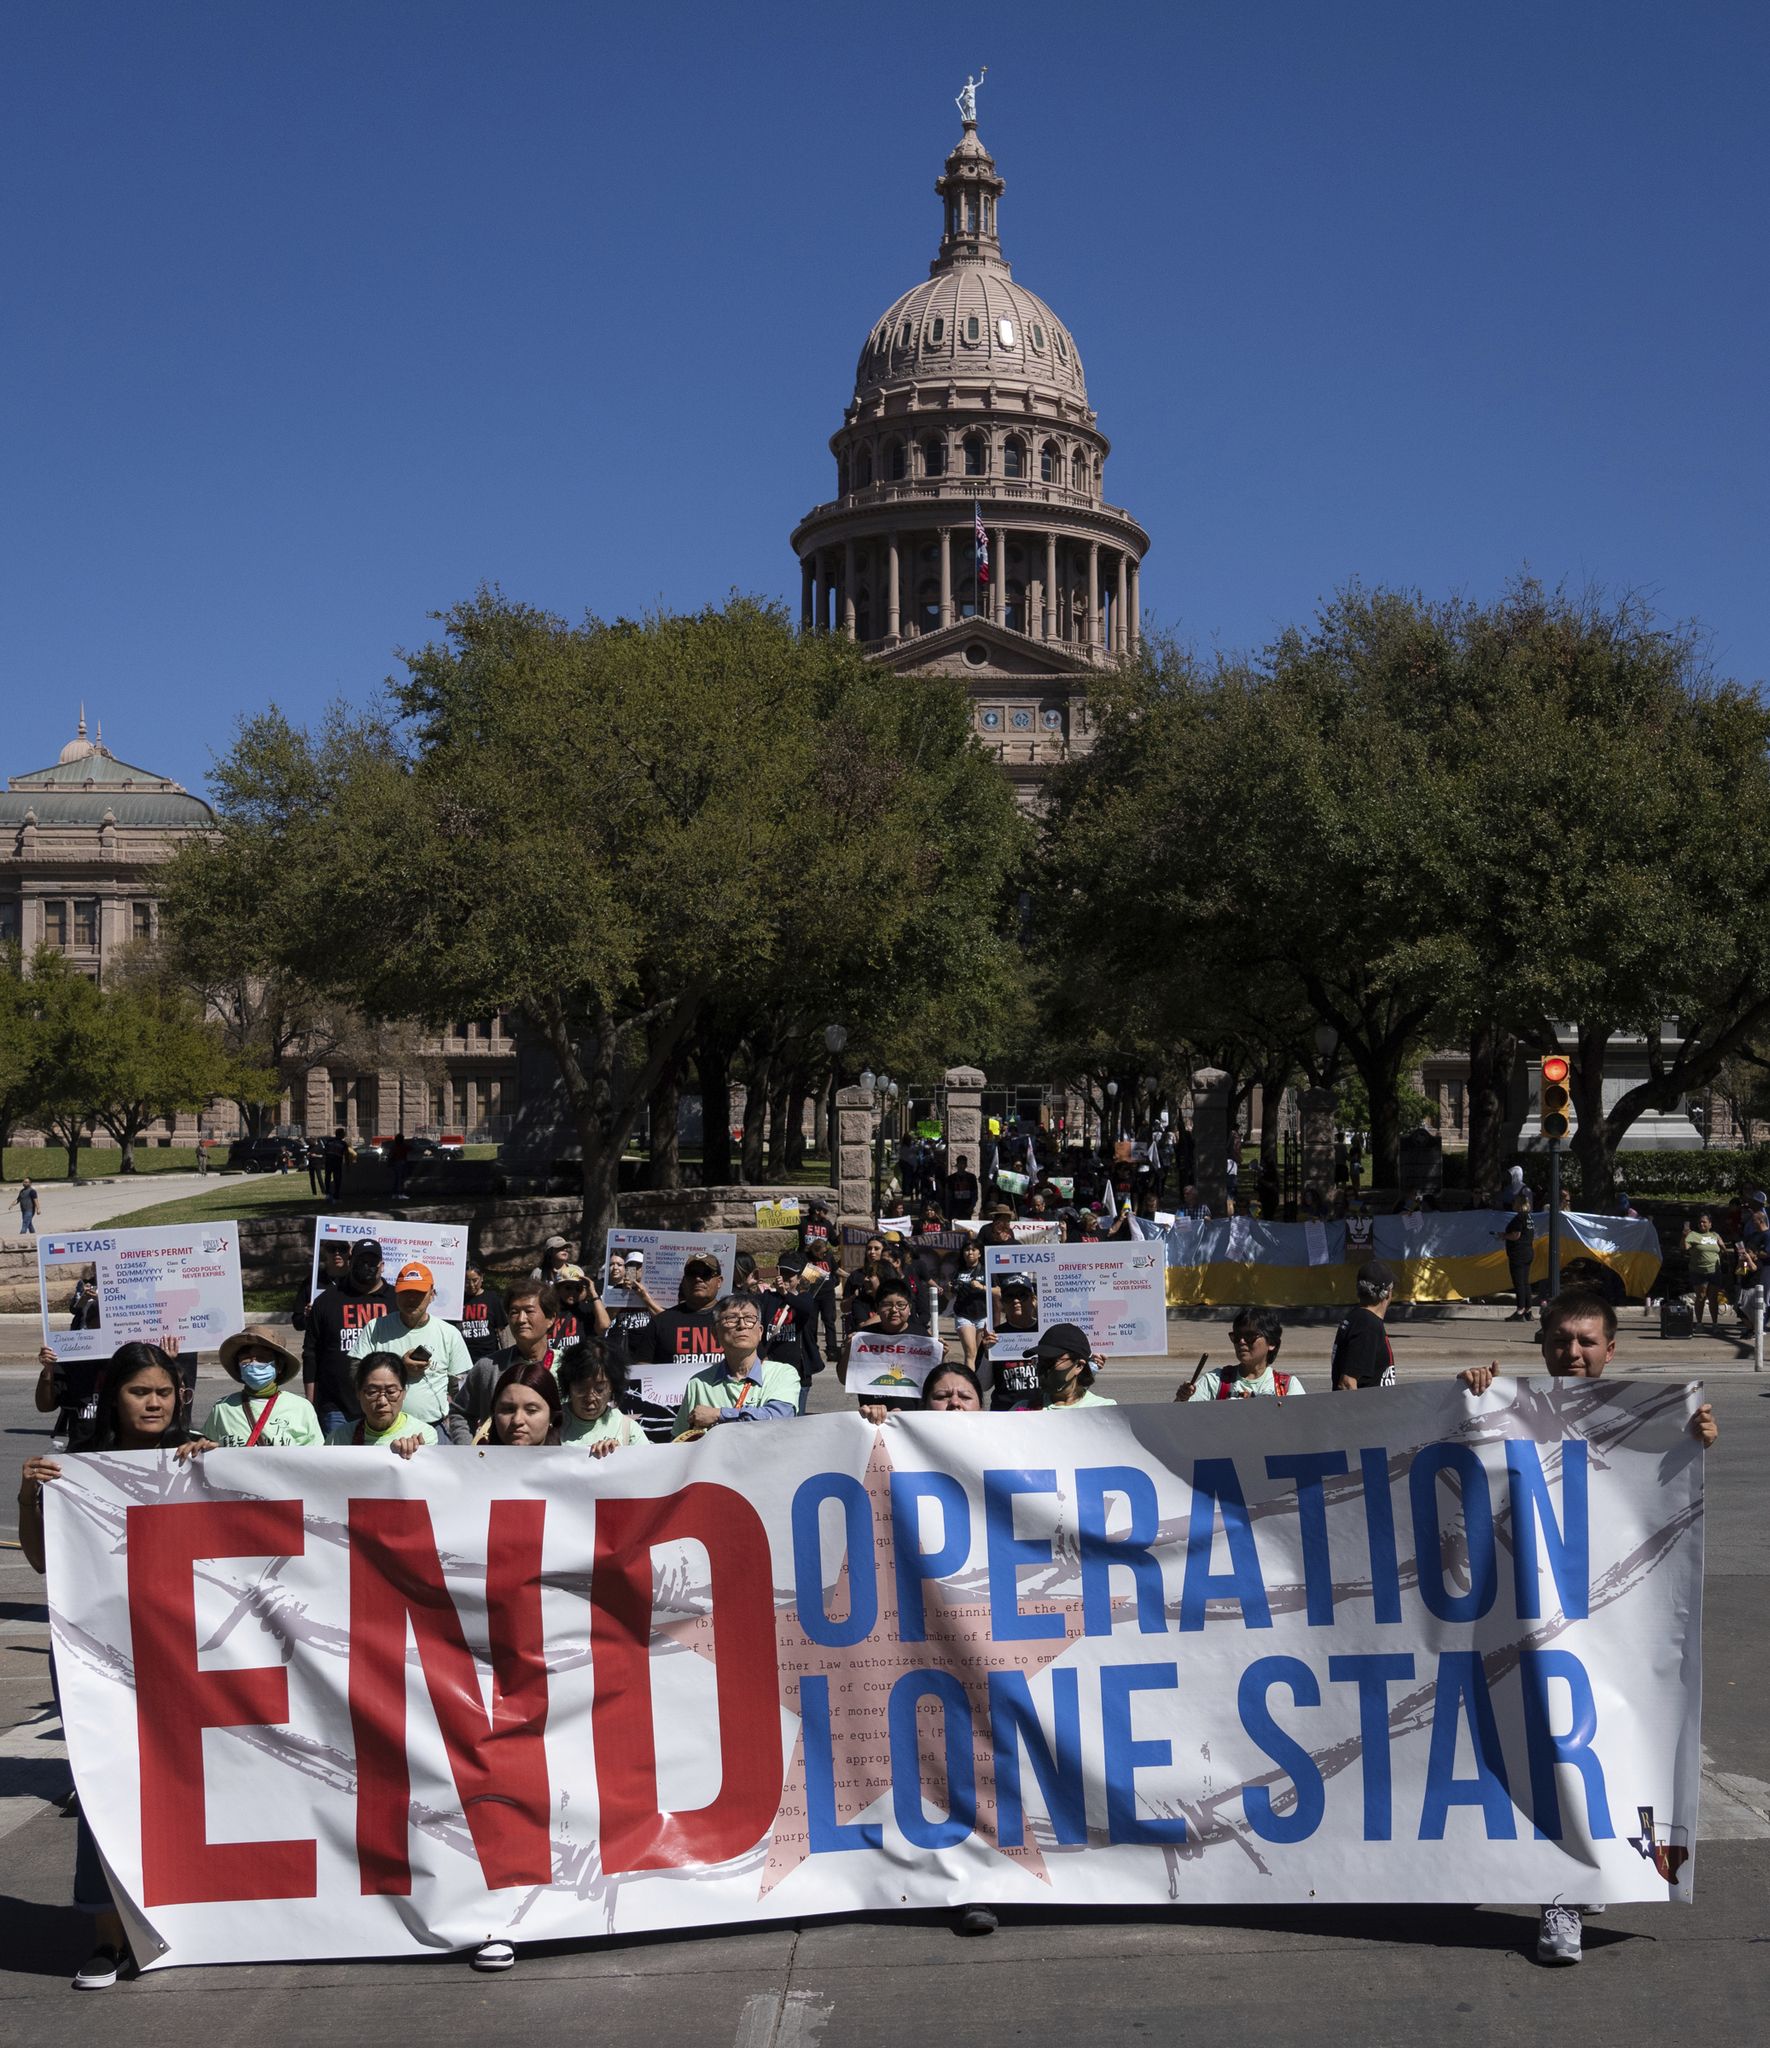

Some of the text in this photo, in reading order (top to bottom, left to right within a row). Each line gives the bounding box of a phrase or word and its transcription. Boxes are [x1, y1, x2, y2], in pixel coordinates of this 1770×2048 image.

[339, 1224, 372, 1235] TEXAS
[807, 1225, 827, 1237] END
[378, 1236, 408, 1245] DRIVER'S
[408, 1239, 433, 1247] PERMIT
[626, 1235, 655, 1244] TEXAS
[67, 1239, 111, 1253] TEXAS
[120, 1247, 193, 1260] DRIVER'S PERMIT
[1011, 1252, 1051, 1264] TEXAS
[115, 1261, 147, 1270] 01234567
[1058, 1263, 1094, 1271] DRIVER'S
[1095, 1262, 1124, 1270] PERMIT
[117, 1268, 163, 1277] DD/MM/YYYY
[117, 1275, 163, 1285] DD/MM/YYYY
[1055, 1286, 1096, 1294] DD/MM/YYYY
[104, 1294, 126, 1302] JOHN
[465, 1303, 488, 1320] ND
[190, 1314, 210, 1322] NONE
[54, 1333, 74, 1343] Drive
[60, 1342, 92, 1352] Adelante
[857, 1344, 906, 1354] ARISE
[791, 1439, 1590, 1648] OPERATION
[1034, 1604, 1057, 1615] the
[780, 1637, 794, 1647] in
[963, 1631, 978, 1642] of
[819, 1659, 841, 1670] law
[849, 1655, 924, 1669] authorizes
[932, 1654, 959, 1666] the
[961, 1654, 1005, 1666] office
[1013, 1655, 1028, 1664] to
[840, 1682, 897, 1692] of Cour
[126, 1482, 784, 1908] END
[848, 1707, 886, 1717] money
[799, 1649, 1617, 1854] LONE STAR
[838, 1803, 852, 1812] to
[769, 1858, 783, 1868] 2.
